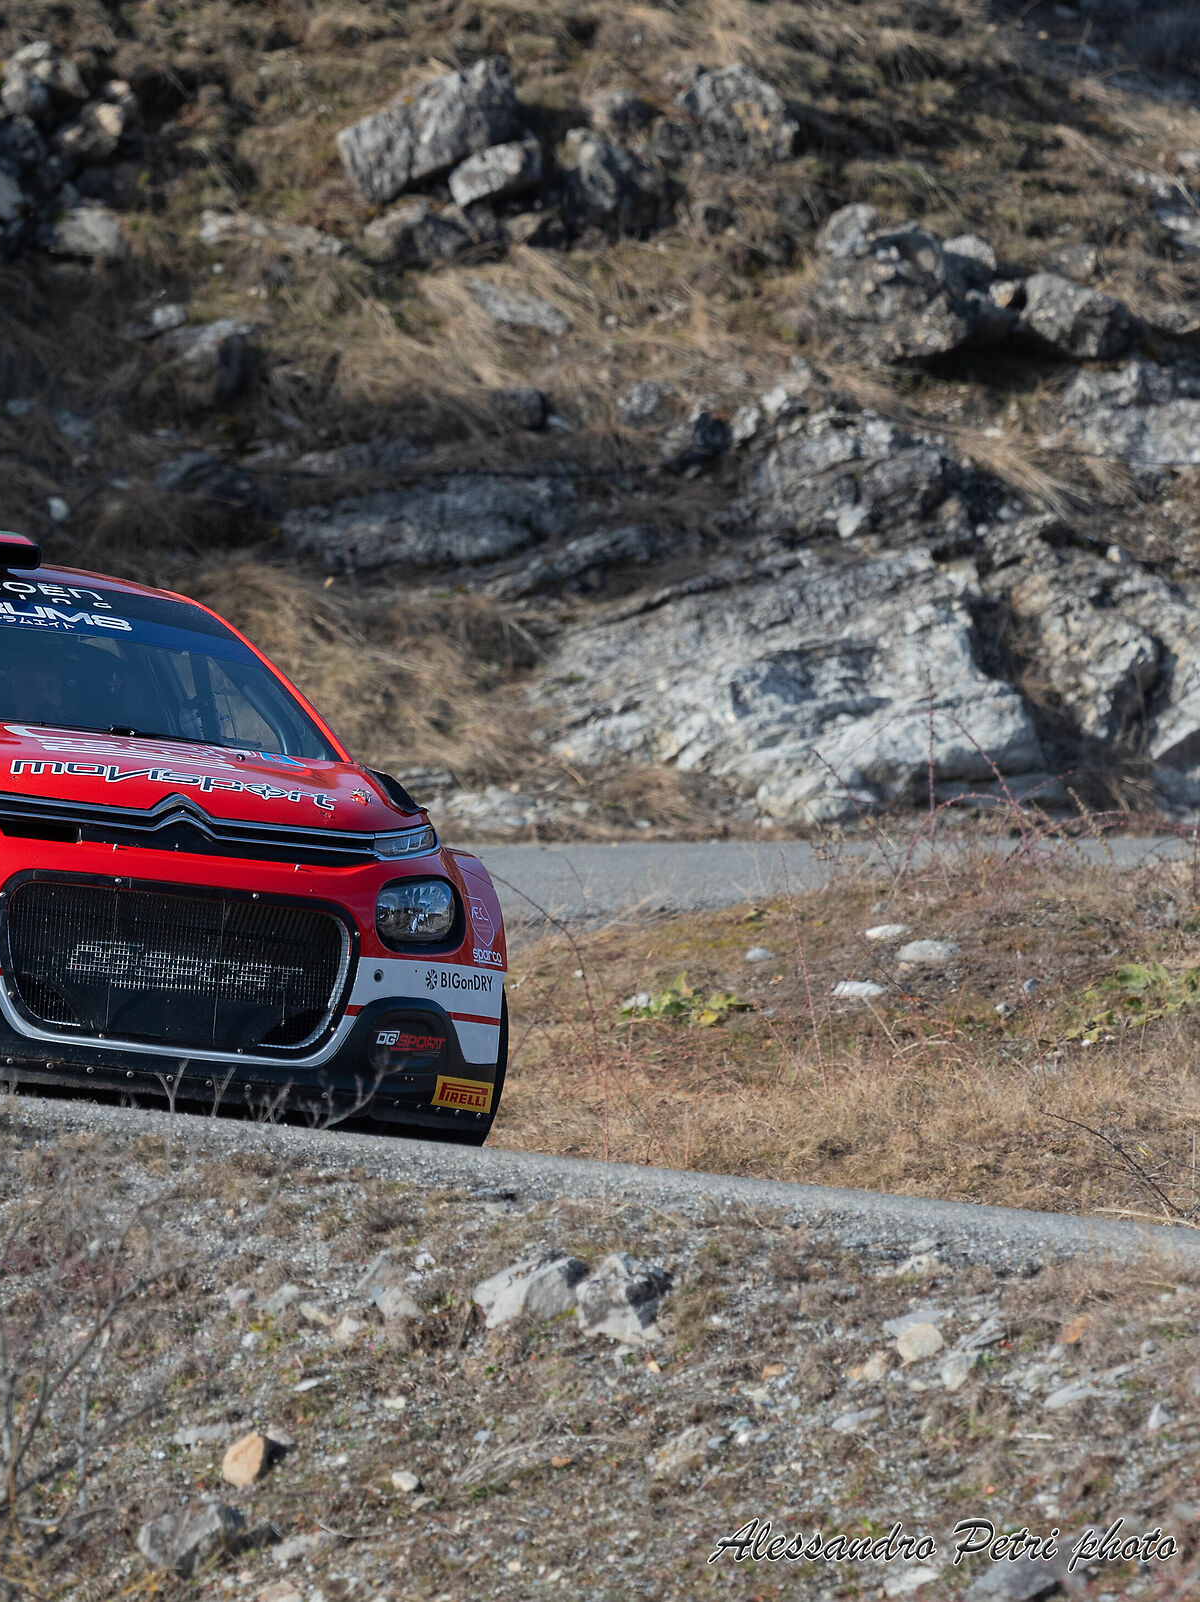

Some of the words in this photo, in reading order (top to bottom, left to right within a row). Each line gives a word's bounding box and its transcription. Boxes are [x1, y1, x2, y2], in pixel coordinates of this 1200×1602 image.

[472, 947, 503, 964] sparco
[440, 971, 493, 992] BIGonDRY
[397, 1033, 446, 1051] SPORT
[438, 1081, 489, 1108] PIRELLI
